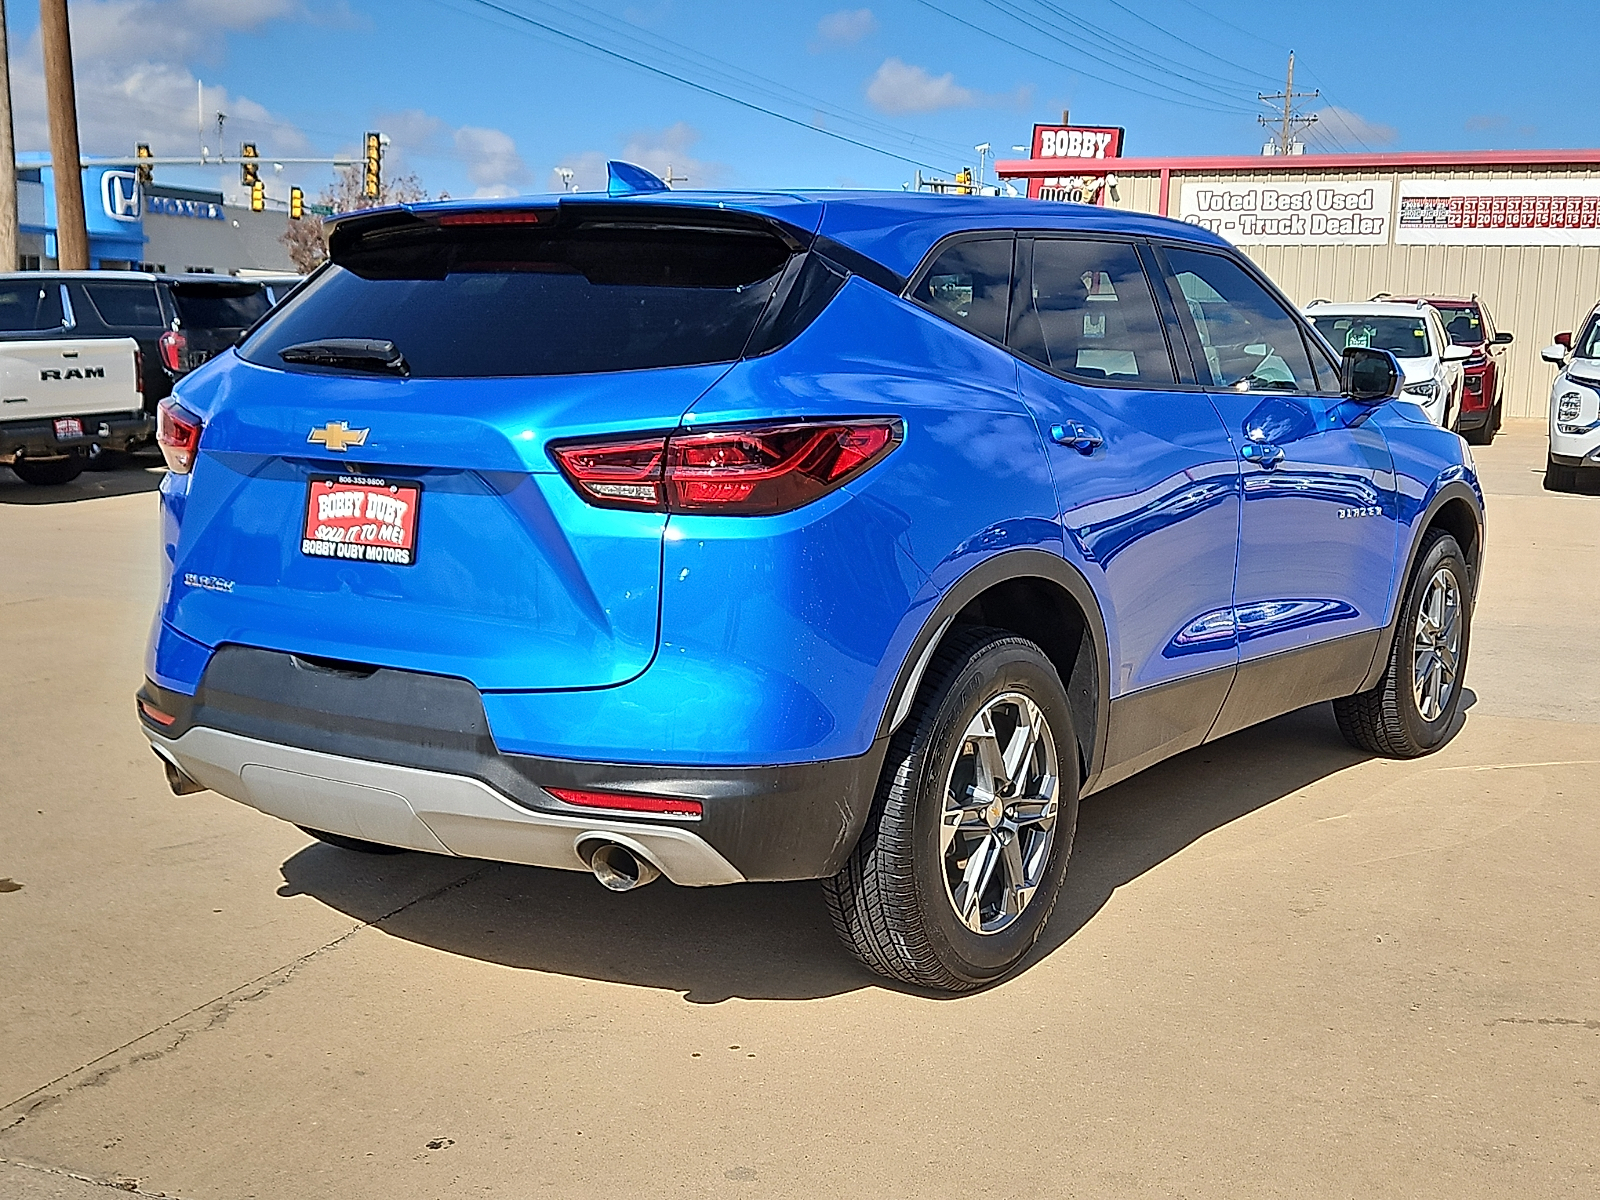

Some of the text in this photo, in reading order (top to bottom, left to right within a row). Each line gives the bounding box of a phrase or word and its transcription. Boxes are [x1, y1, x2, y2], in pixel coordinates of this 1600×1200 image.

[1041, 130, 1112, 159] BOBBY
[1197, 189, 1373, 211] Voted Best Used
[1239, 214, 1305, 235] Truck
[1310, 214, 1384, 235] Dealer
[1449, 214, 1594, 224] 22 21 20 19 18 17 15 14 13 12
[40, 367, 105, 381] RAM
[318, 491, 408, 526] BOBBY DUBY
[1338, 506, 1382, 519] BLAZER
[315, 523, 405, 546] SOLD IT TO ME!
[302, 539, 410, 564] BOBBY DUBY MOTORS
